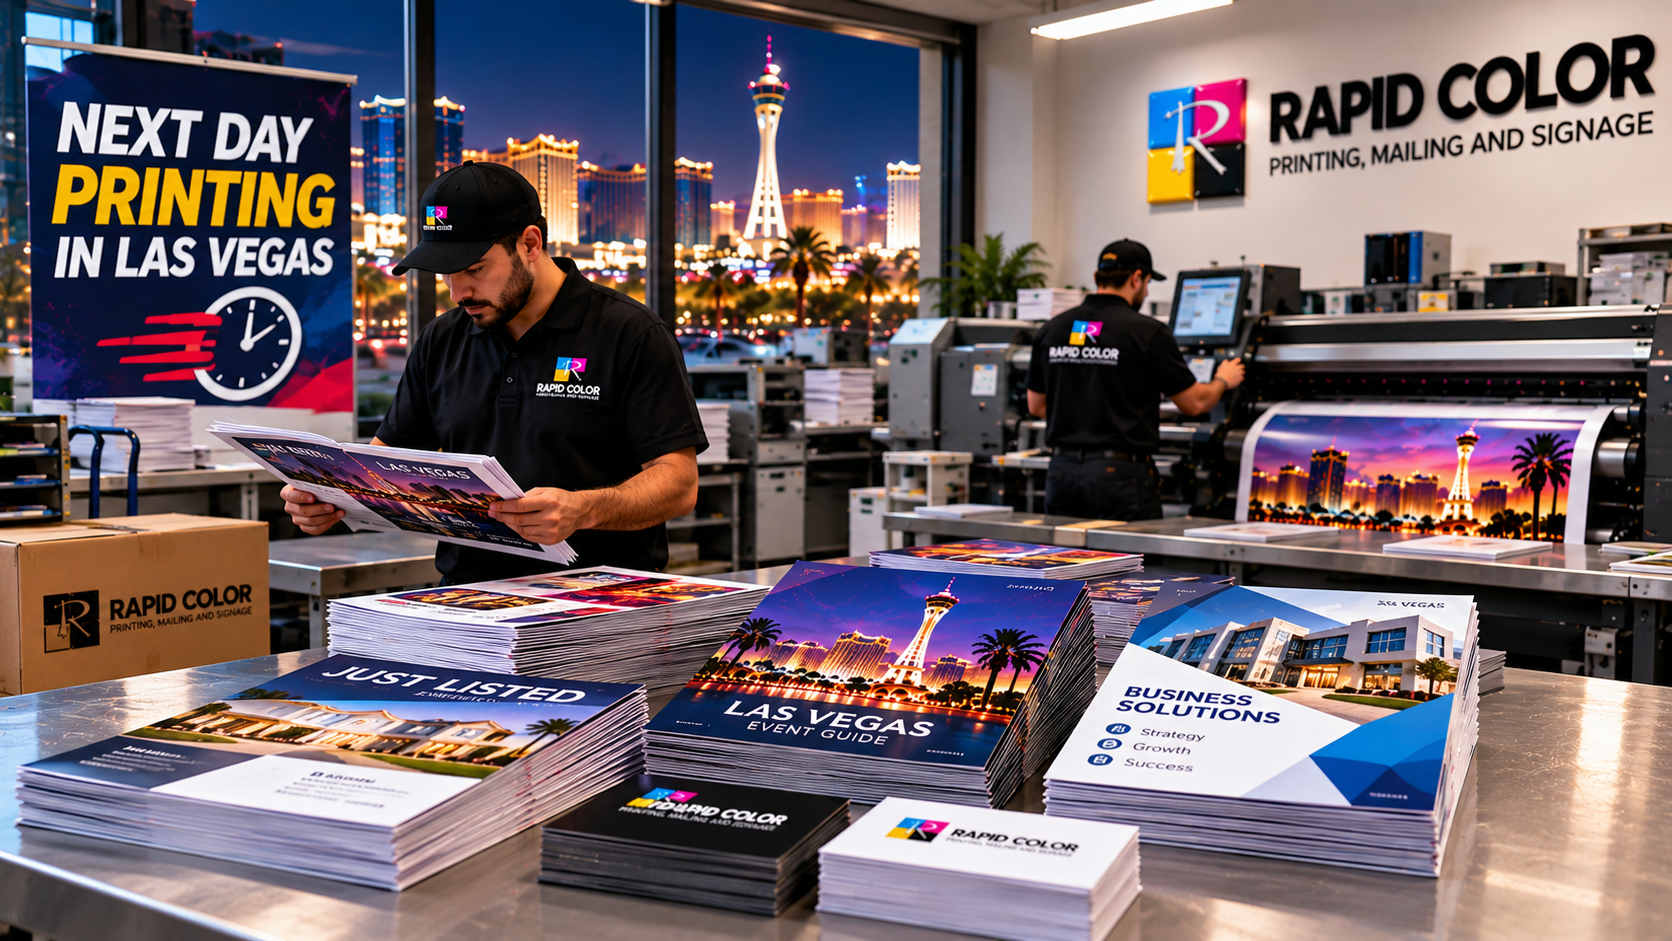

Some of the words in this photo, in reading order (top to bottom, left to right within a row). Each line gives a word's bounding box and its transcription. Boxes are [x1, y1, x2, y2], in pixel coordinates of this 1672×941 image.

[1269, 72, 1425, 143] RAPID
[1437, 34, 1655, 121] COLOR
[56, 101, 203, 158] NEXT
[213, 112, 314, 163] DAY
[1269, 147, 1366, 176] PRINTING,
[1371, 135, 1464, 165] MAILING
[1470, 128, 1524, 154] AND
[1532, 110, 1654, 147] SIGNAGE
[51, 163, 336, 229] PRINTING
[54, 236, 104, 278] IN
[114, 236, 197, 278] LAS
[208, 236, 335, 277] VEGAS
[1048, 346, 1080, 358] RAPID
[1081, 346, 1120, 360] COLOR
[536, 382, 565, 393] RAPID
[566, 384, 601, 396] COLOR
[375, 460, 411, 473] LAS
[412, 465, 471, 480] VEGAS
[109, 593, 177, 621] RAPID
[182, 584, 252, 610] COLOR
[110, 619, 156, 633] PRINTING,
[157, 613, 193, 627] MAILING
[195, 611, 215, 621] AND
[216, 606, 253, 618] SIGNAGE
[321, 666, 437, 688] JUST
[433, 678, 586, 703] LISTED
[1124, 686, 1253, 706] BUSINESS
[723, 700, 797, 721] LAS
[809, 708, 935, 737] VEGAS
[1116, 700, 1281, 724] SOLUTIONS
[746, 720, 817, 737] EVENT
[820, 729, 889, 746] GUIDE
[1140, 728, 1206, 742] Strategy
[1132, 742, 1192, 755] Growth
[1123, 757, 1194, 772] Success
[720, 808, 789, 826] COLOR
[950, 828, 1009, 843] RAPID
[1012, 836, 1079, 852] COLOR
